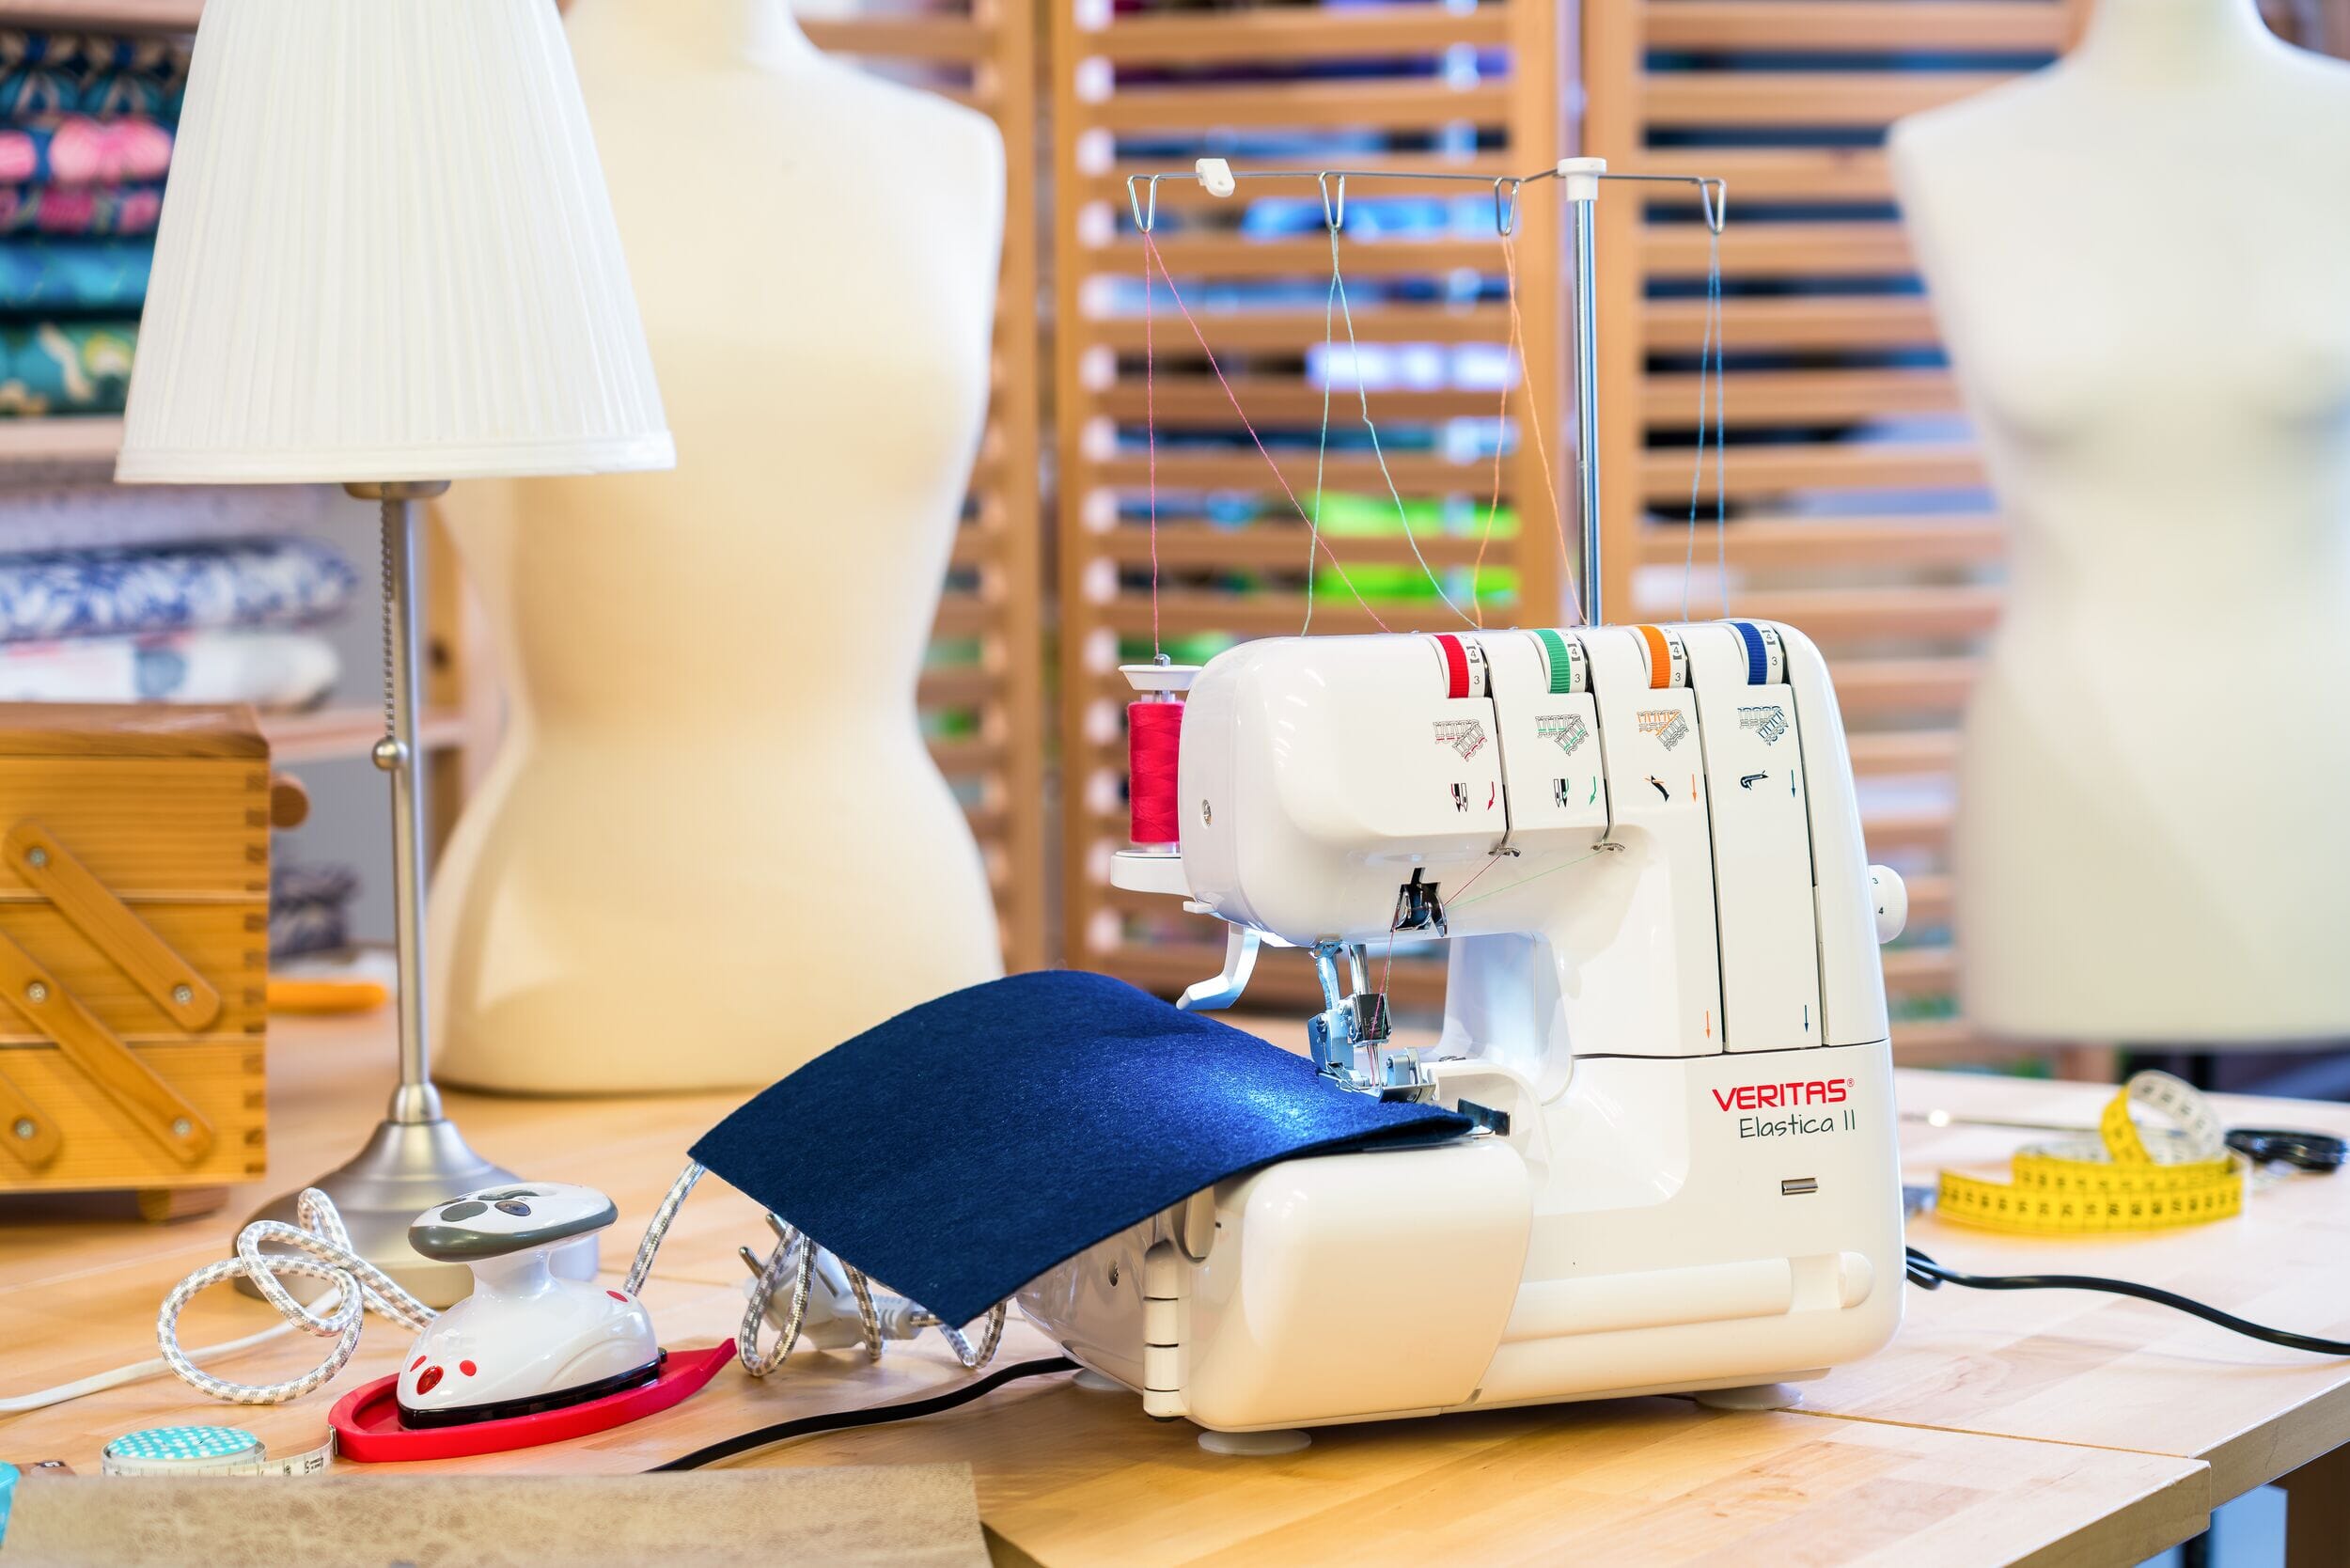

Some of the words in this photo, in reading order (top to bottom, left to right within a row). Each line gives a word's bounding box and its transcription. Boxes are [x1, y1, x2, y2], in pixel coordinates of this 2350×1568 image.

[1771, 656, 1778, 666] 3
[1473, 675, 1480, 685] 3
[1574, 673, 1581, 683] 3
[1675, 672, 1682, 682] 3
[1739, 1113, 1834, 1138] Elastica
